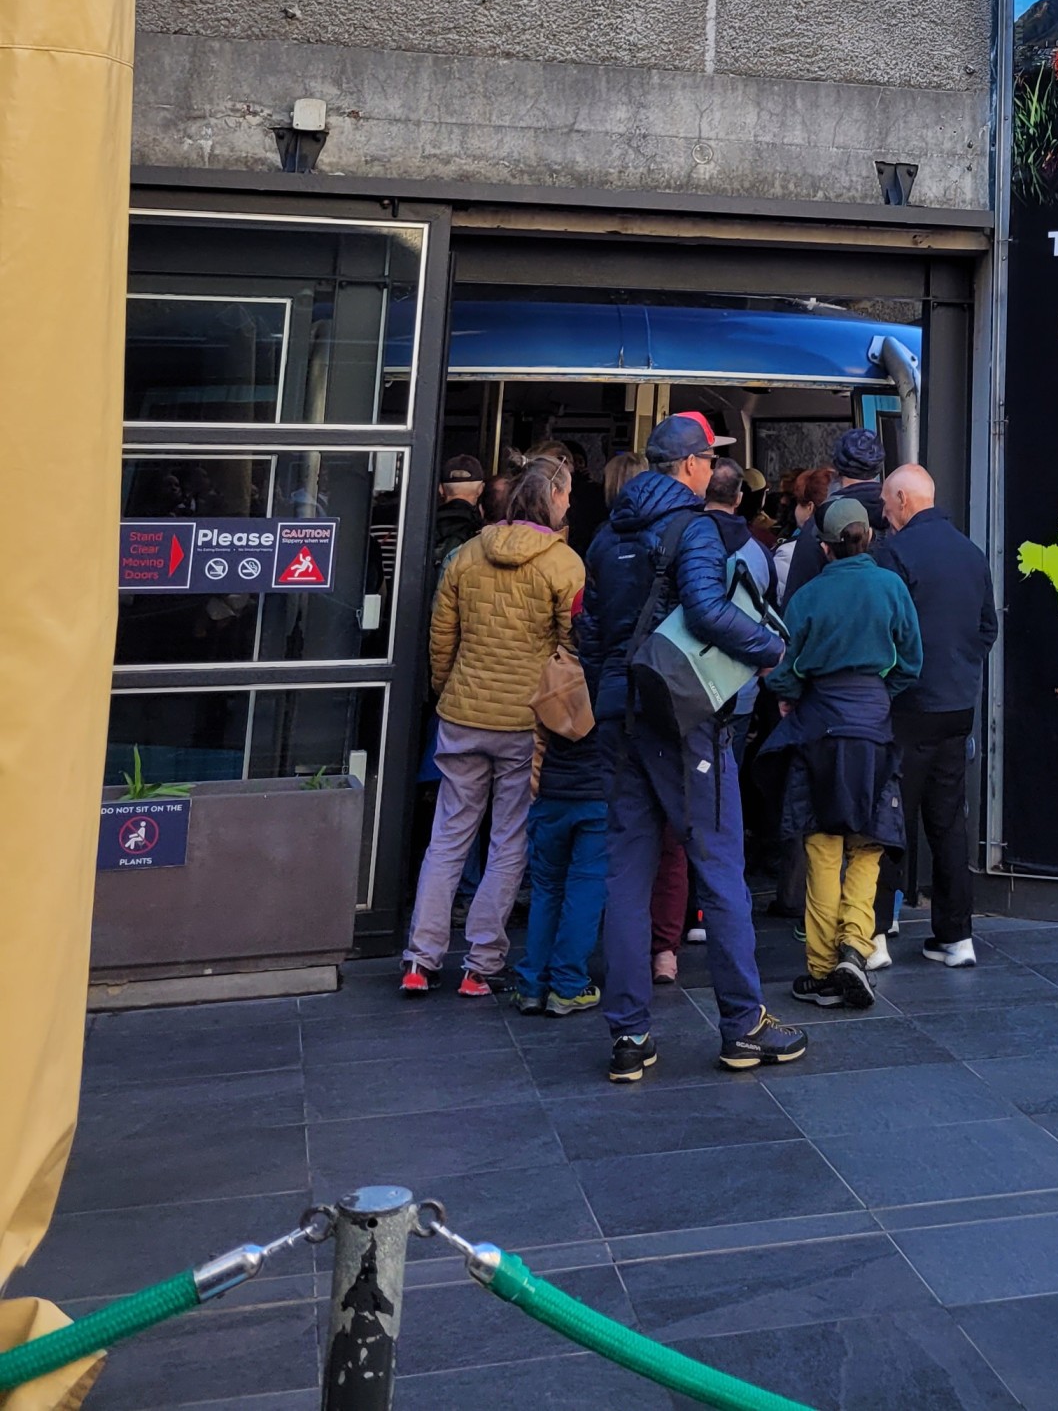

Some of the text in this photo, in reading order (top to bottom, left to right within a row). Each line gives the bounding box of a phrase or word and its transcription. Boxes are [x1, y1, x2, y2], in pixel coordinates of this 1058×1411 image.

[129, 532, 164, 542] Stand
[197, 529, 275, 546] Please
[281, 529, 331, 538] CAUTION
[130, 544, 160, 554] Clear
[122, 557, 164, 568] Moving
[124, 570, 160, 580] Doors
[101, 807, 114, 815] DO
[116, 806, 134, 814] NOT
[119, 857, 152, 865] PLANTS
